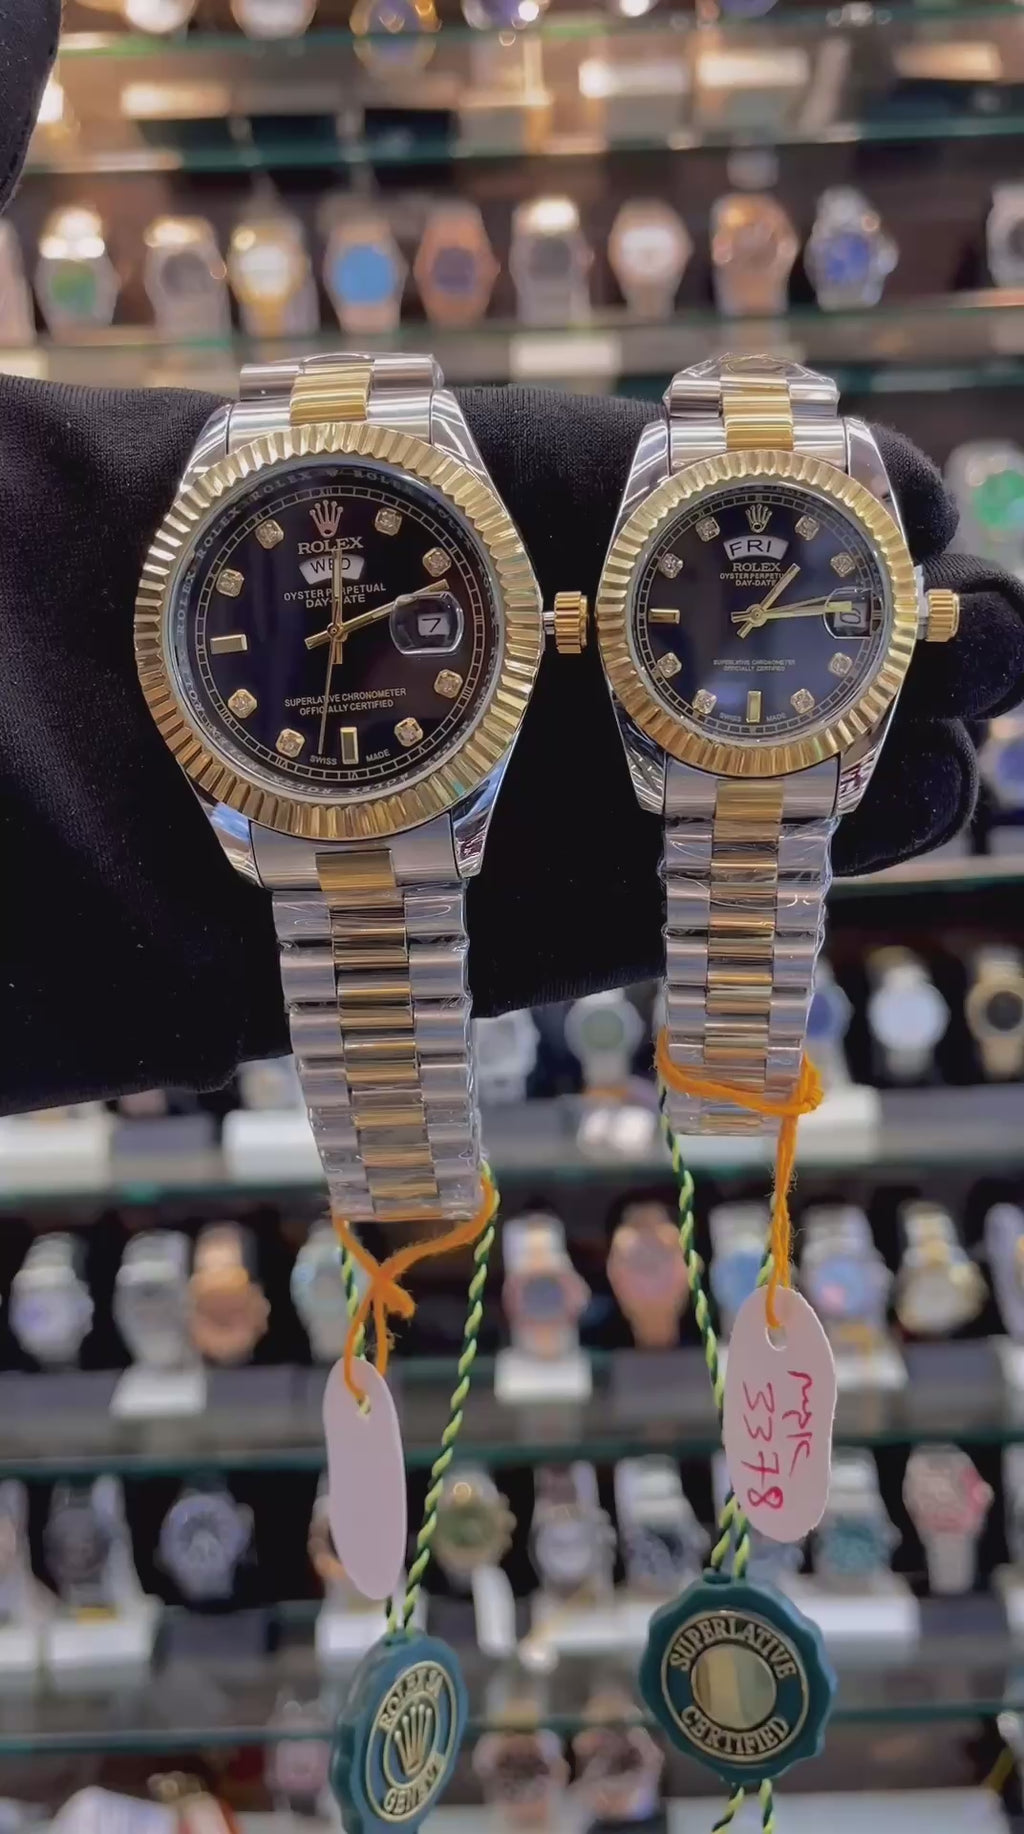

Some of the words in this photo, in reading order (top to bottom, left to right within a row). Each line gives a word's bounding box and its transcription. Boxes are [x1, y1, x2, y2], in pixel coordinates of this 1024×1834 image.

[297, 536, 364, 555] ROLEX
[728, 539, 772, 557] FRI
[732, 562, 781, 572] ROLEX
[283, 589, 324, 602] OYSTER
[325, 583, 387, 598] PPETUAL
[305, 594, 367, 609] DAY-ATE
[421, 617, 442, 633] 7
[284, 694, 340, 708] SUPERLATVE
[341, 687, 407, 700] CHRONOMETER
[299, 703, 349, 716] OFFICALLY
[350, 699, 394, 712] CERTIFIED
[309, 755, 338, 766] SWISS
[365, 748, 391, 763] MADE
[741, 1381, 784, 1510] 3378
[670, 1617, 797, 1679] SUPERLATIVE
[681, 1705, 790, 1755] CERTIFIED
